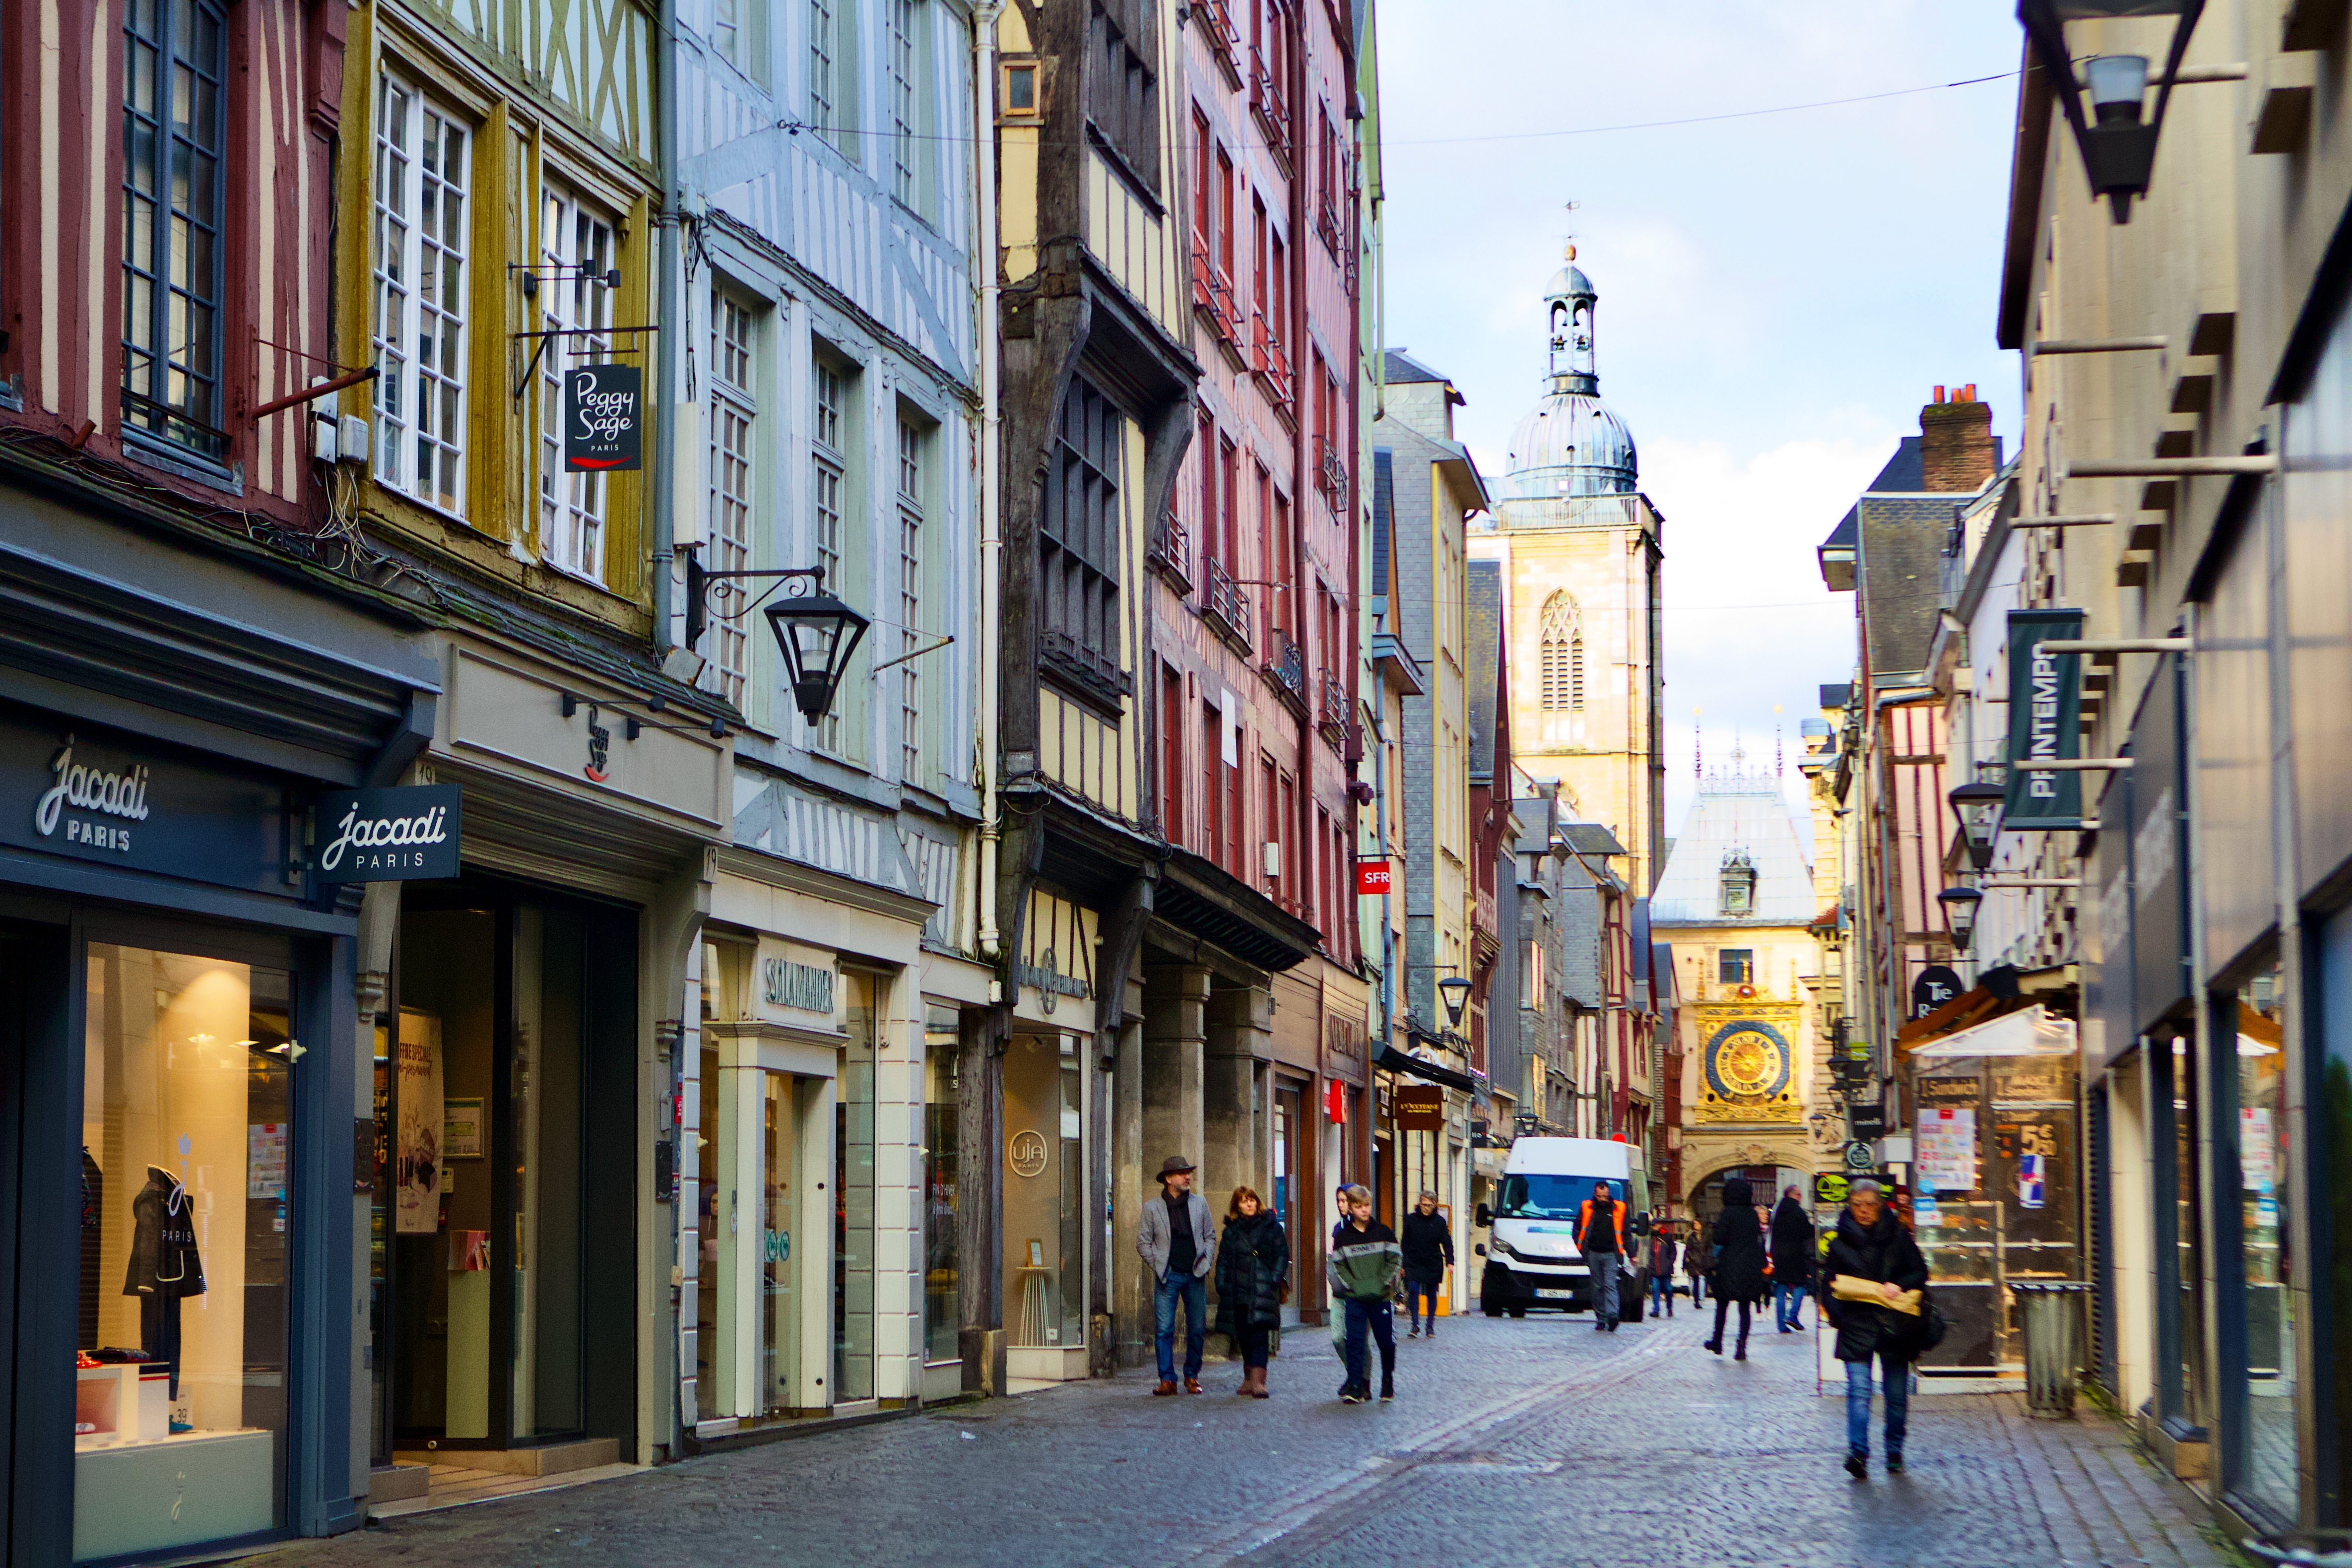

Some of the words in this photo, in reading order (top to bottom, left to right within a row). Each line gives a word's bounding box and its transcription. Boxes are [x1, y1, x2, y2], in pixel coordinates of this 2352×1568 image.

[576, 372, 634, 417] Peggy
[575, 408, 633, 441] Sage
[589, 704, 610, 751] Peggy
[587, 738, 608, 774] Sage
[36, 732, 149, 836] jacadi
[67, 819, 130, 851] PARIS
[322, 801, 447, 871] jacadi
[356, 852, 423, 869] PARIS
[706, 848, 717, 878] 19
[1365, 871, 1389, 884] SFR
[766, 958, 834, 1014] SALAMANDER
[162, 1230, 191, 1242] PARIS
